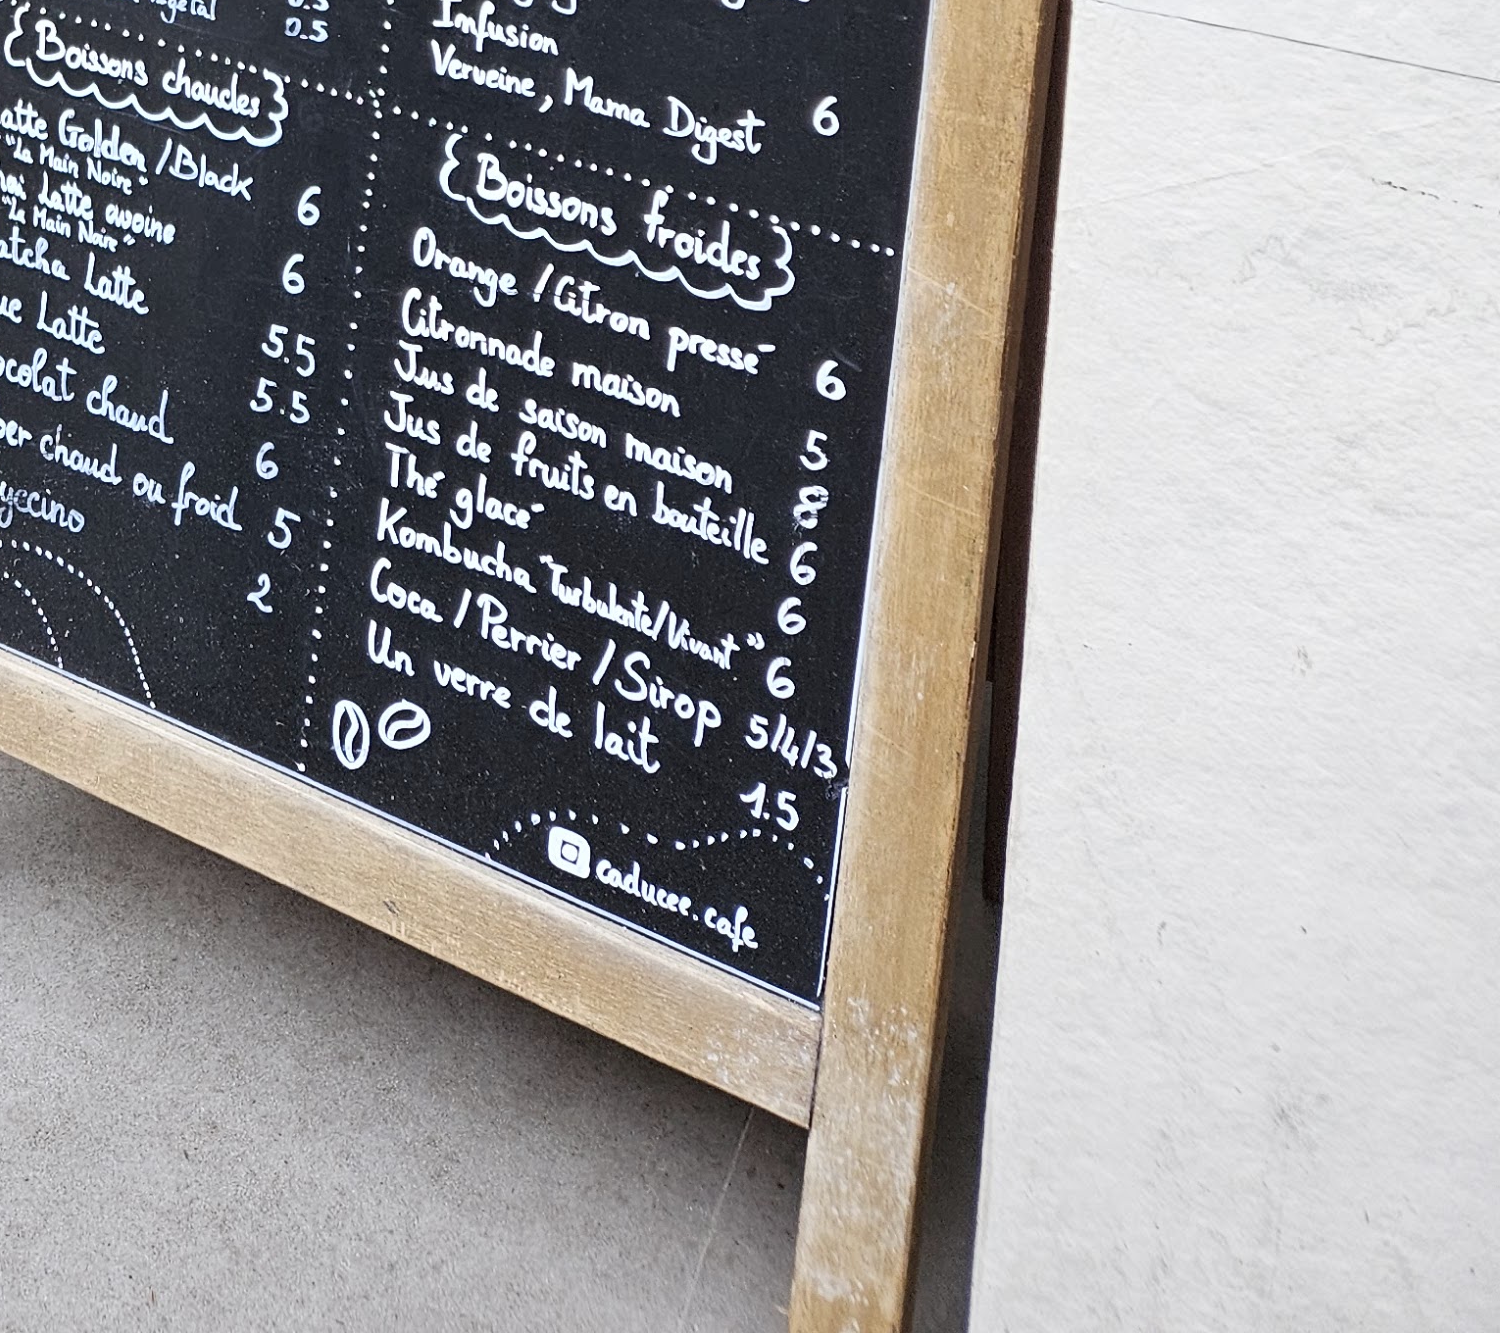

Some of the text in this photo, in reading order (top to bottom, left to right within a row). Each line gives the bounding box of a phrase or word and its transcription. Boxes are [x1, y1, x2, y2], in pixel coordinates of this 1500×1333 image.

[36, 19, 262, 118] Boissons chaudes
[284, 17, 330, 42] 0.5
[39, 143, 79, 179] Main
[59, 109, 147, 172] Golden
[296, 185, 322, 225] 6
[564, 67, 651, 130] Mama
[663, 95, 767, 165] Digest
[813, 95, 841, 137] 6
[32, 201, 72, 239] Main
[37, 170, 95, 221] Latte
[105, 205, 176, 244] avoine
[281, 253, 305, 295] 6
[476, 152, 761, 282] Boissons froides
[37, 290, 107, 354] Latte
[249, 377, 312, 425] 5.5
[83, 252, 150, 316] Latte
[261, 323, 317, 377] 5.5
[413, 226, 847, 402] Orange pressé 6
[86, 374, 175, 445] chaud
[254, 442, 280, 481] 6
[393, 339, 830, 531] Jus de saison maison 8
[401, 287, 830, 472] Citronnade maison 5
[38, 422, 123, 486] chaud
[132, 472, 167, 506] ou
[171, 460, 243, 532] froid
[267, 507, 302, 551] 5
[383, 390, 819, 587] Jus de fruits en bouteille 6
[384, 441, 807, 636] Thé glacé 6
[246, 573, 274, 615] 2
[375, 496, 797, 700] Kombucha 6
[367, 620, 800, 831] Un verre de lait 1.5
[369, 557, 838, 781] Coca 5/4/3
